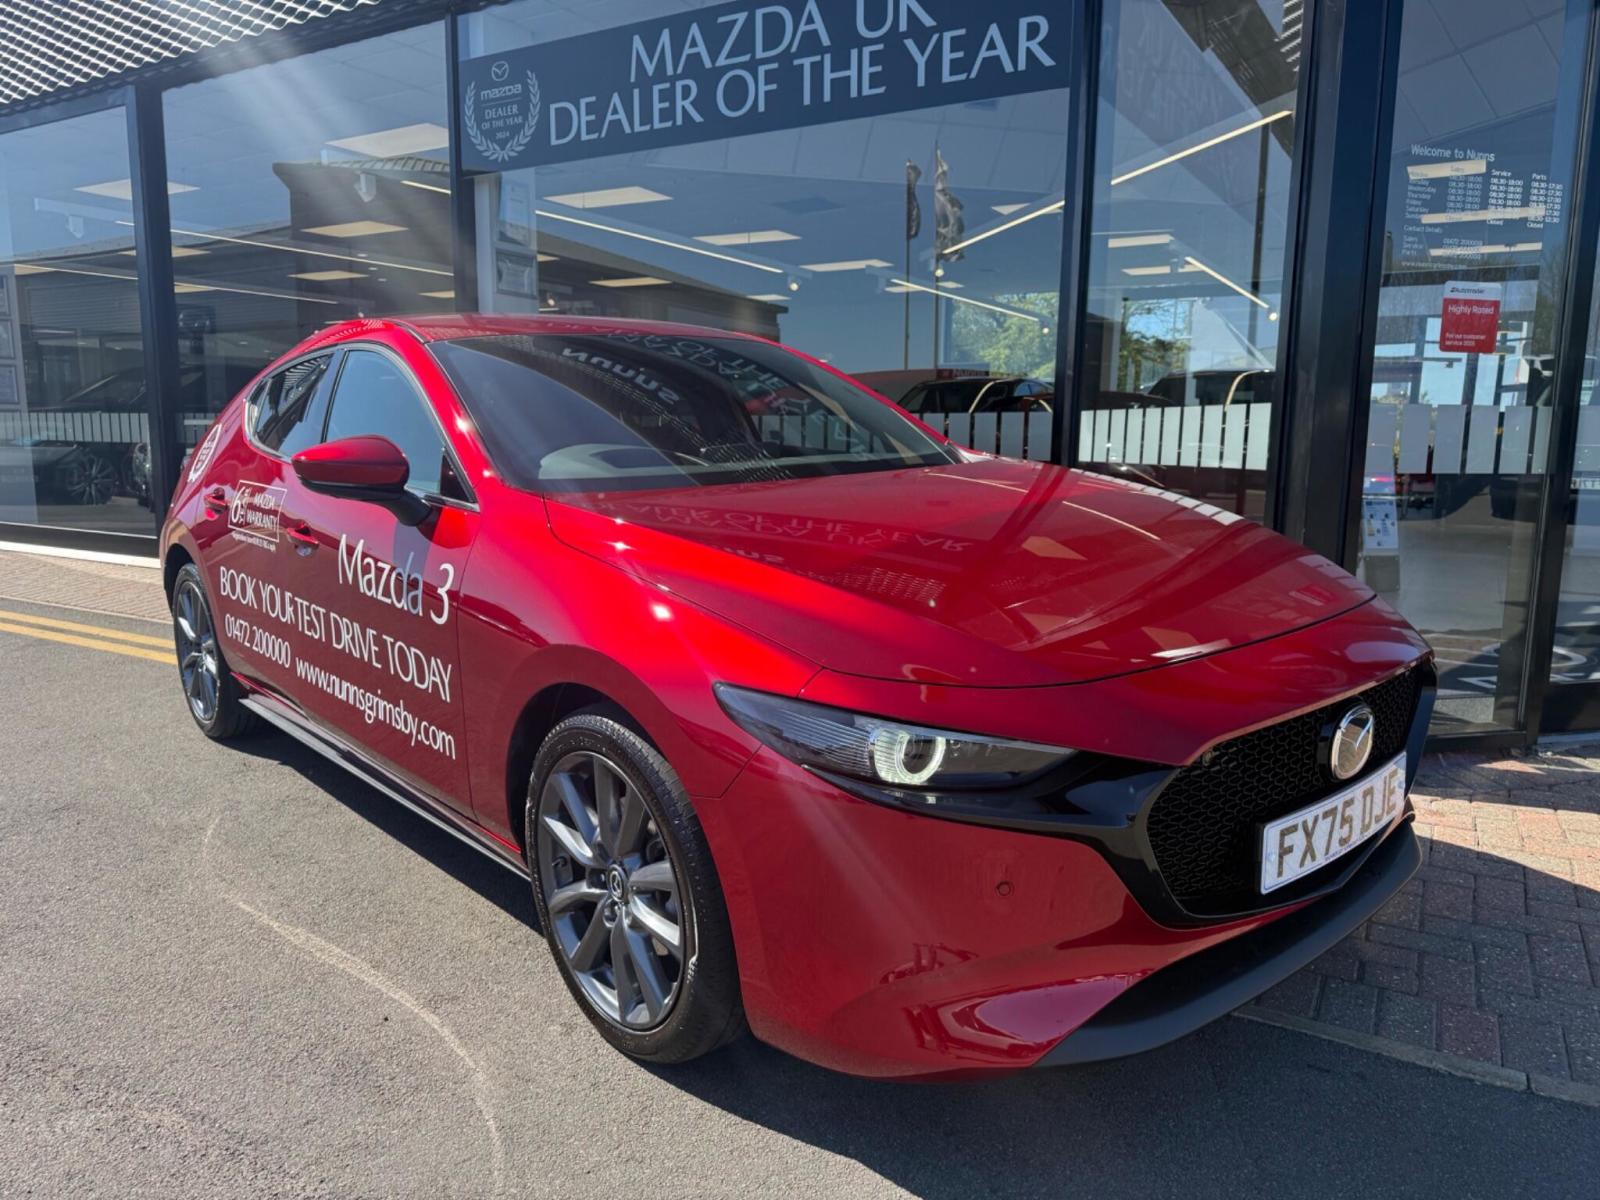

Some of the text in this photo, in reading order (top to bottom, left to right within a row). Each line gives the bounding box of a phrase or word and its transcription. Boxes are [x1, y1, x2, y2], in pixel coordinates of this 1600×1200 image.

[549, 14, 1057, 147] DEALER OF THE YEAR
[629, 0, 832, 83] MAZDA
[484, 104, 519, 120] DEALER
[492, 118, 504, 129] THE
[505, 115, 523, 126] YEAR
[1411, 144, 1451, 158] Welcome
[1454, 149, 1464, 158] to
[1448, 304, 1495, 316] Highly Rated
[337, 533, 456, 625] Mazda 3
[219, 565, 452, 703] BOOK YOUR TEST DRIVE TODAY
[224, 613, 456, 760] 01472 200000 www.nunnsgrimsby.com
[1276, 796, 1355, 879] FX75
[1359, 768, 1399, 836] DJE
